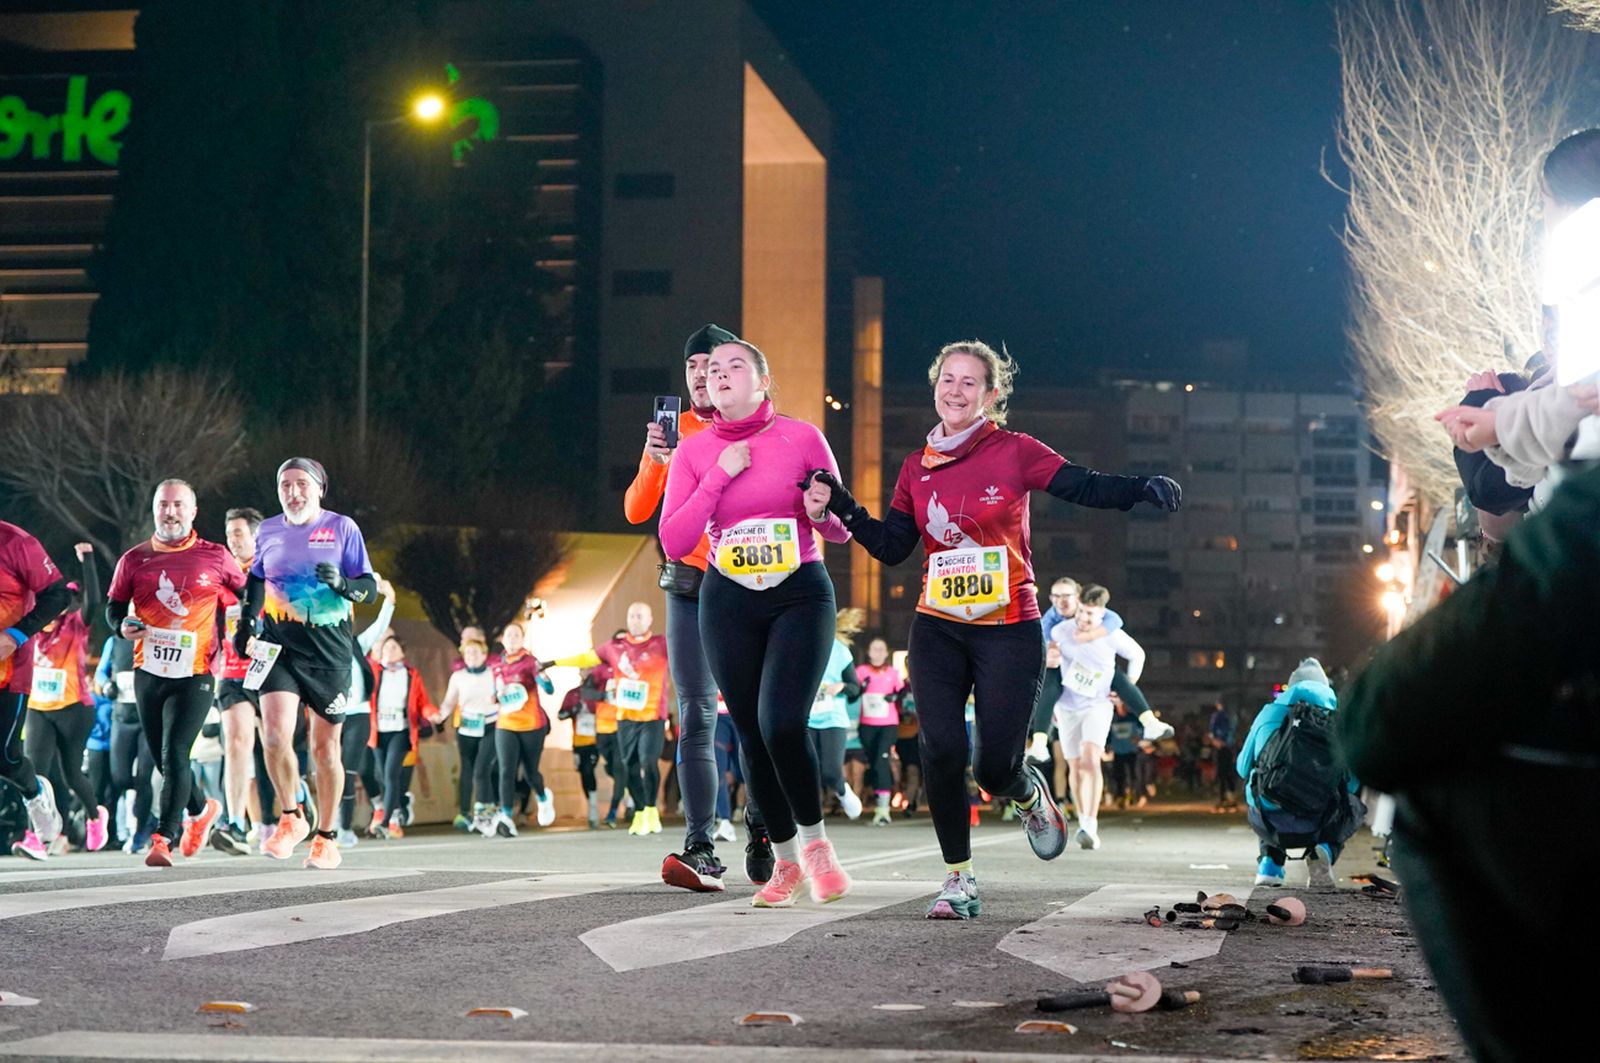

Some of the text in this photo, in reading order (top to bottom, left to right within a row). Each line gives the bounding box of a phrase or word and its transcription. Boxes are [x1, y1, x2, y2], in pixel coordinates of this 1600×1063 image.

[724, 538, 740, 546] SAN
[943, 529, 964, 544] 43
[732, 543, 784, 568] 3881
[937, 567, 950, 578] SAN
[941, 573, 994, 599] 3880
[153, 645, 183, 663] 5177
